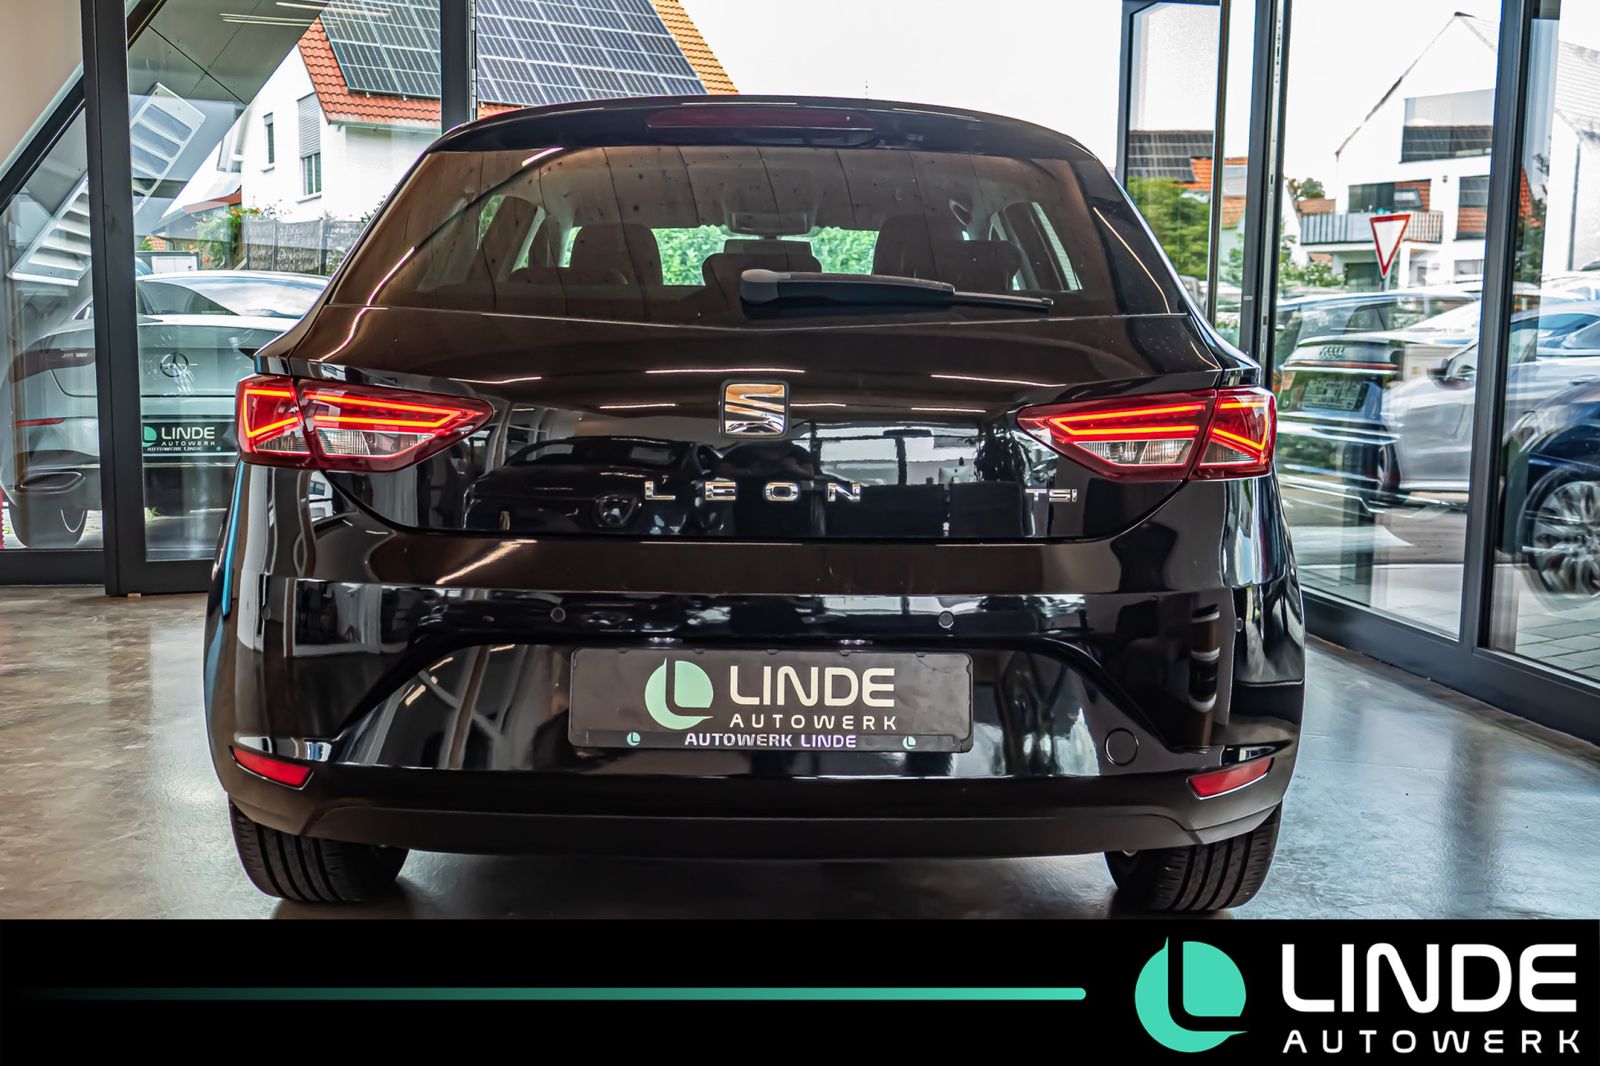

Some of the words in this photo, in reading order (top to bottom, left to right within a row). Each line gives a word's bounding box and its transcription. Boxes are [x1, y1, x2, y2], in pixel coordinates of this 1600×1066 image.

[161, 427, 215, 439] LINDE
[644, 481, 861, 502] LEON
[1025, 488, 1077, 503] TSI
[730, 665, 895, 707] LINDE
[729, 714, 897, 730] AUTOWERK
[685, 732, 793, 748] AUTOWERK
[801, 735, 857, 748] LINDE
